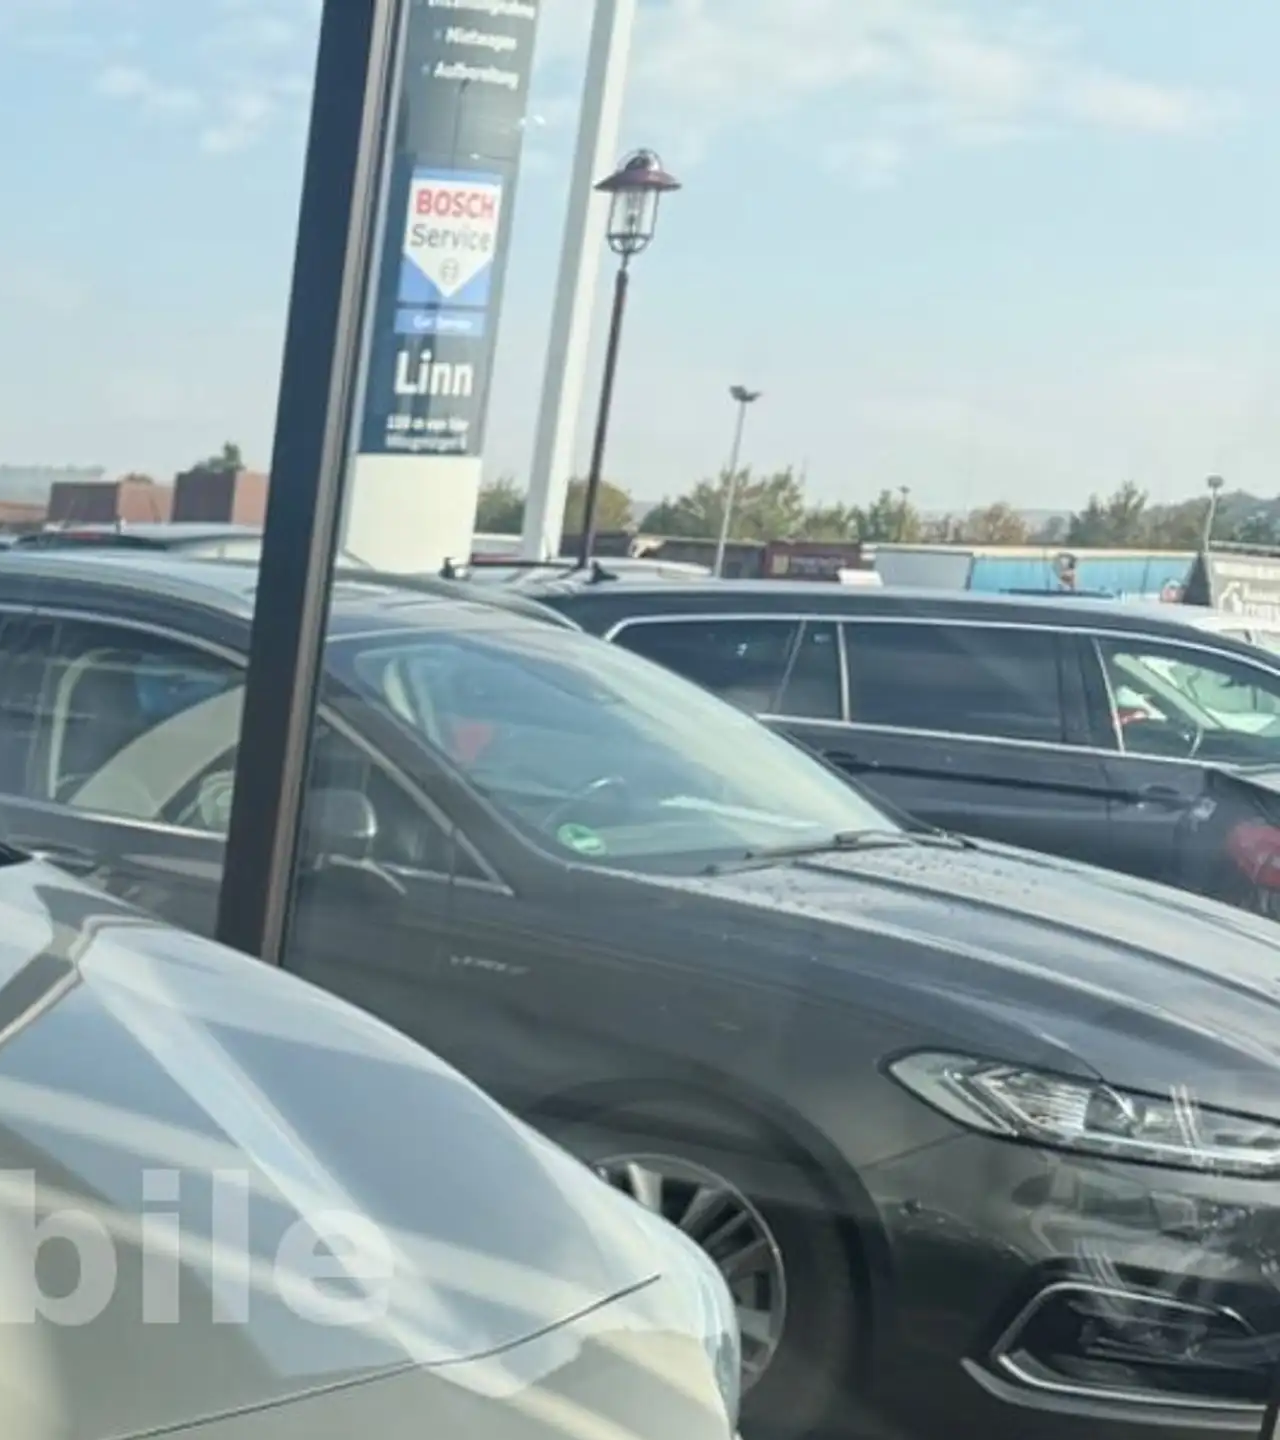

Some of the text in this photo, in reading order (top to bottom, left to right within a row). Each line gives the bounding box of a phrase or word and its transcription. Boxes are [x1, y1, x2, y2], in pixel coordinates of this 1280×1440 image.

[415, 188, 495, 220] BOSCH
[410, 223, 492, 253] Service
[393, 348, 474, 398] Linn
